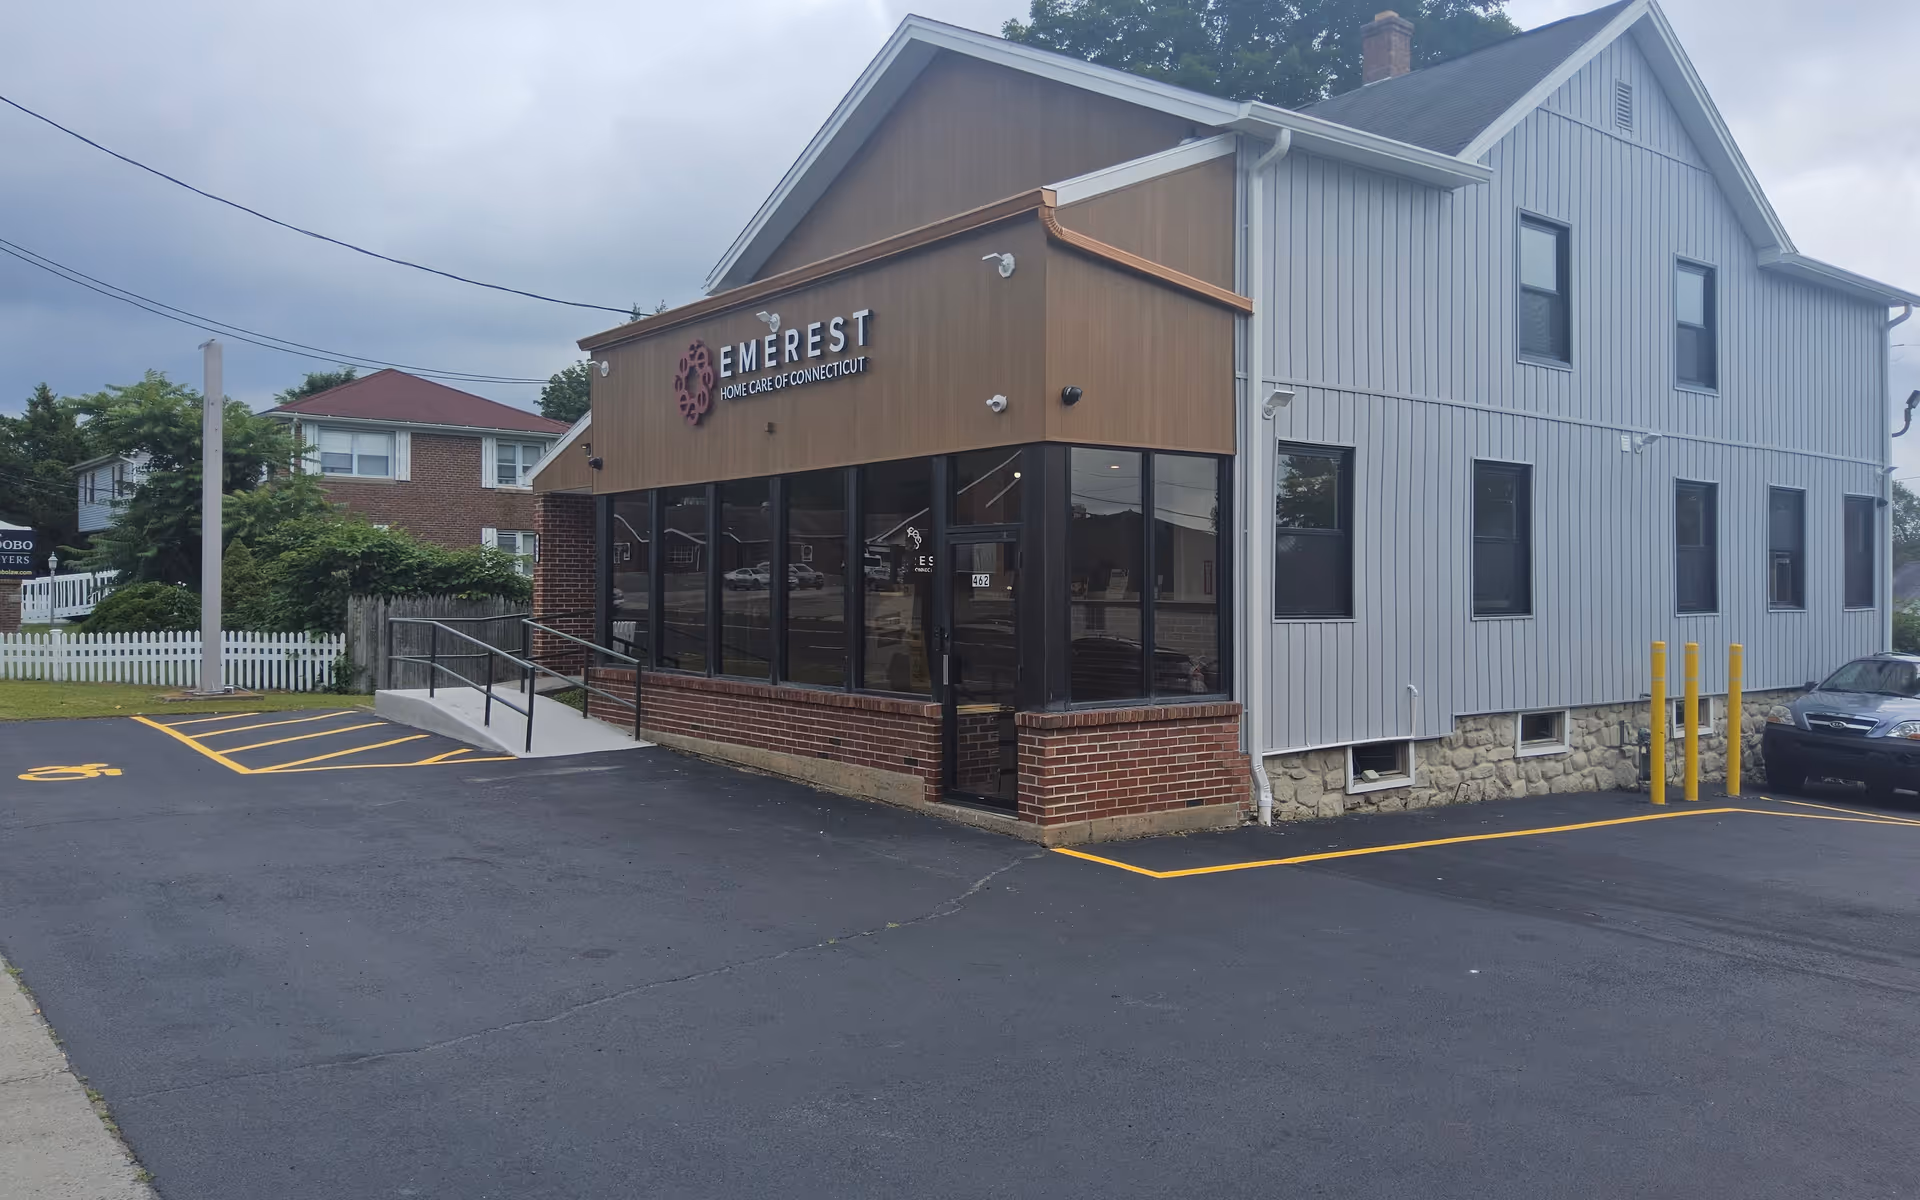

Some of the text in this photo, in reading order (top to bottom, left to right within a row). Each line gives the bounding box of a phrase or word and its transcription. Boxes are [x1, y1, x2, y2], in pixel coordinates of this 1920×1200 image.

[720, 308, 869, 378] EMEREST
[720, 356, 865, 400] HOME CARE OF CONNECTICUT
[0, 540, 33, 550] OBO
[972, 575, 989, 586] 462
